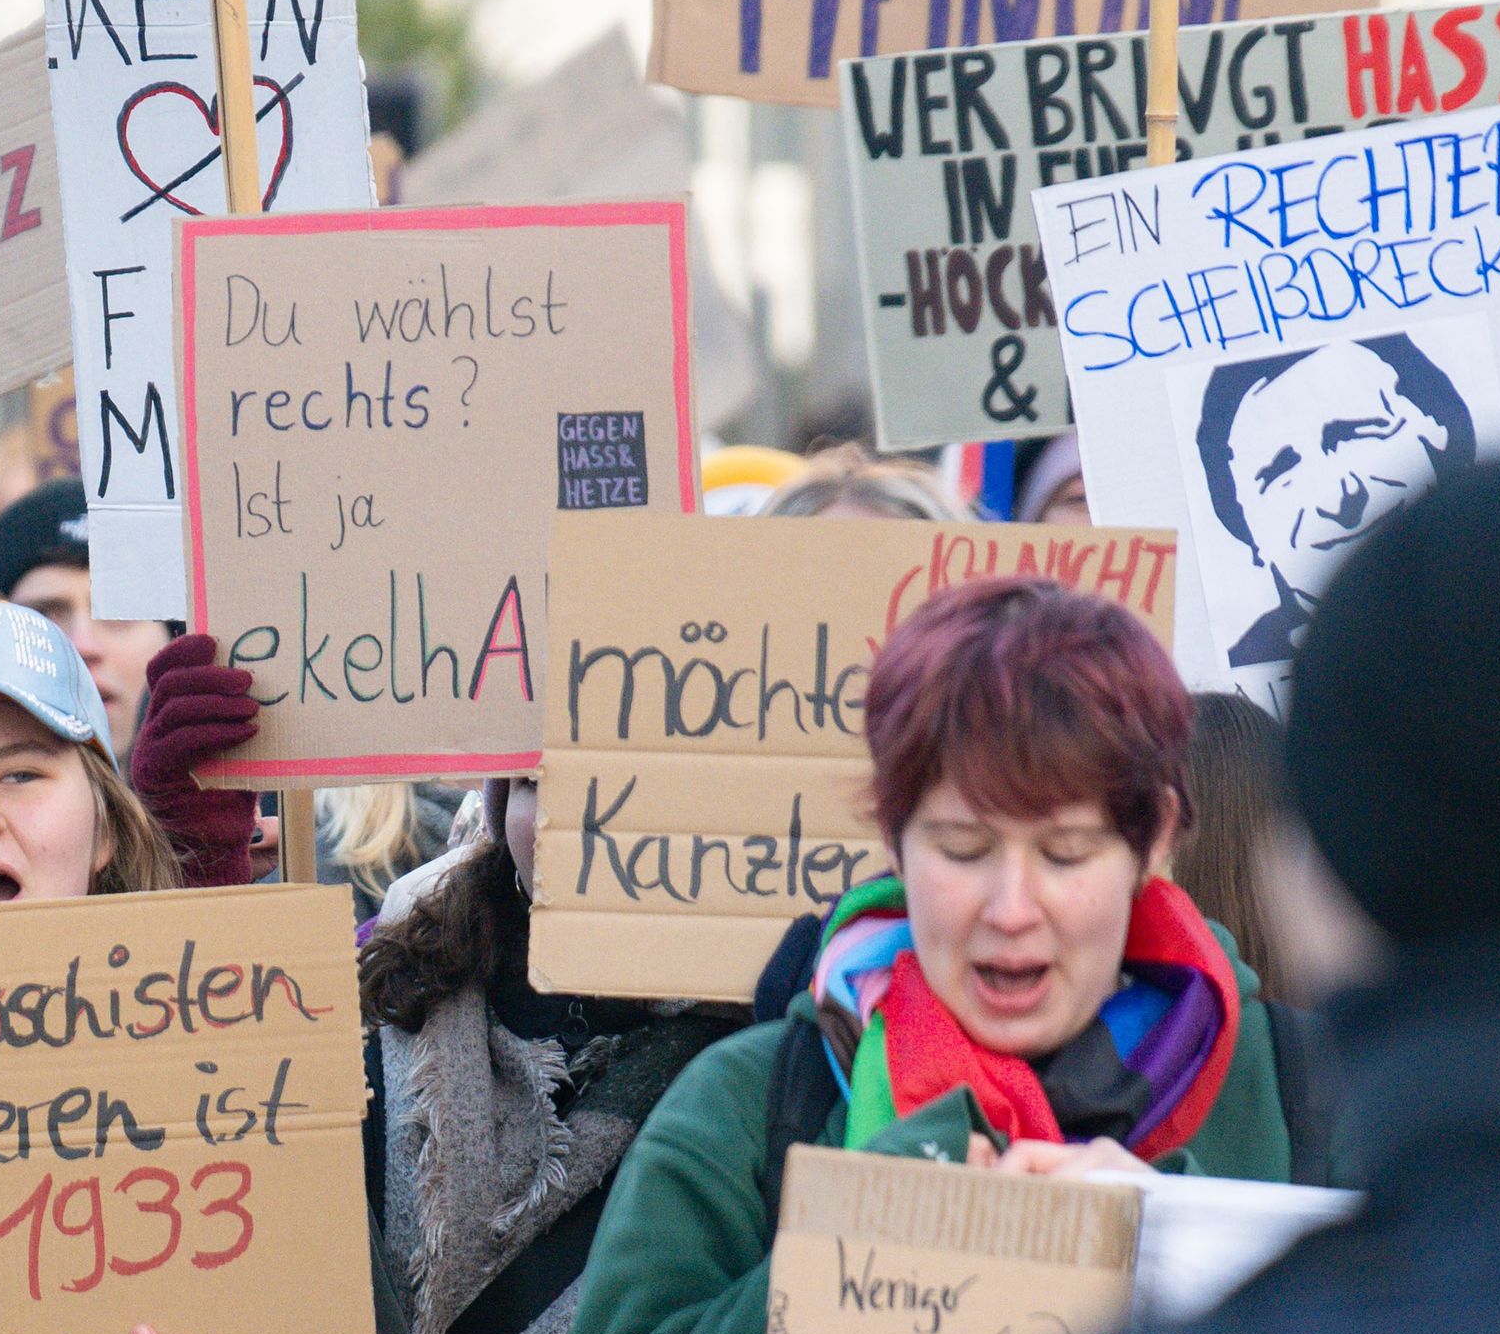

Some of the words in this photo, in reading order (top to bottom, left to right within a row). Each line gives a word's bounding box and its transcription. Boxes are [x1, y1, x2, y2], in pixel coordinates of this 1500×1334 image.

[850, 47, 1006, 161] WER
[943, 154, 1016, 245] IN
[1057, 184, 1162, 267] EIN
[225, 273, 302, 348] Du
[356, 265, 569, 342] wählst
[982, 334, 1038, 423] &
[559, 412, 639, 443] GEGEN
[234, 460, 294, 540] Ist
[332, 476, 386, 549] ja
[564, 474, 643, 508] HETZE
[230, 571, 550, 707] ekelhA
[568, 619, 870, 743] möchte
[196, 1057, 310, 1147] ist
